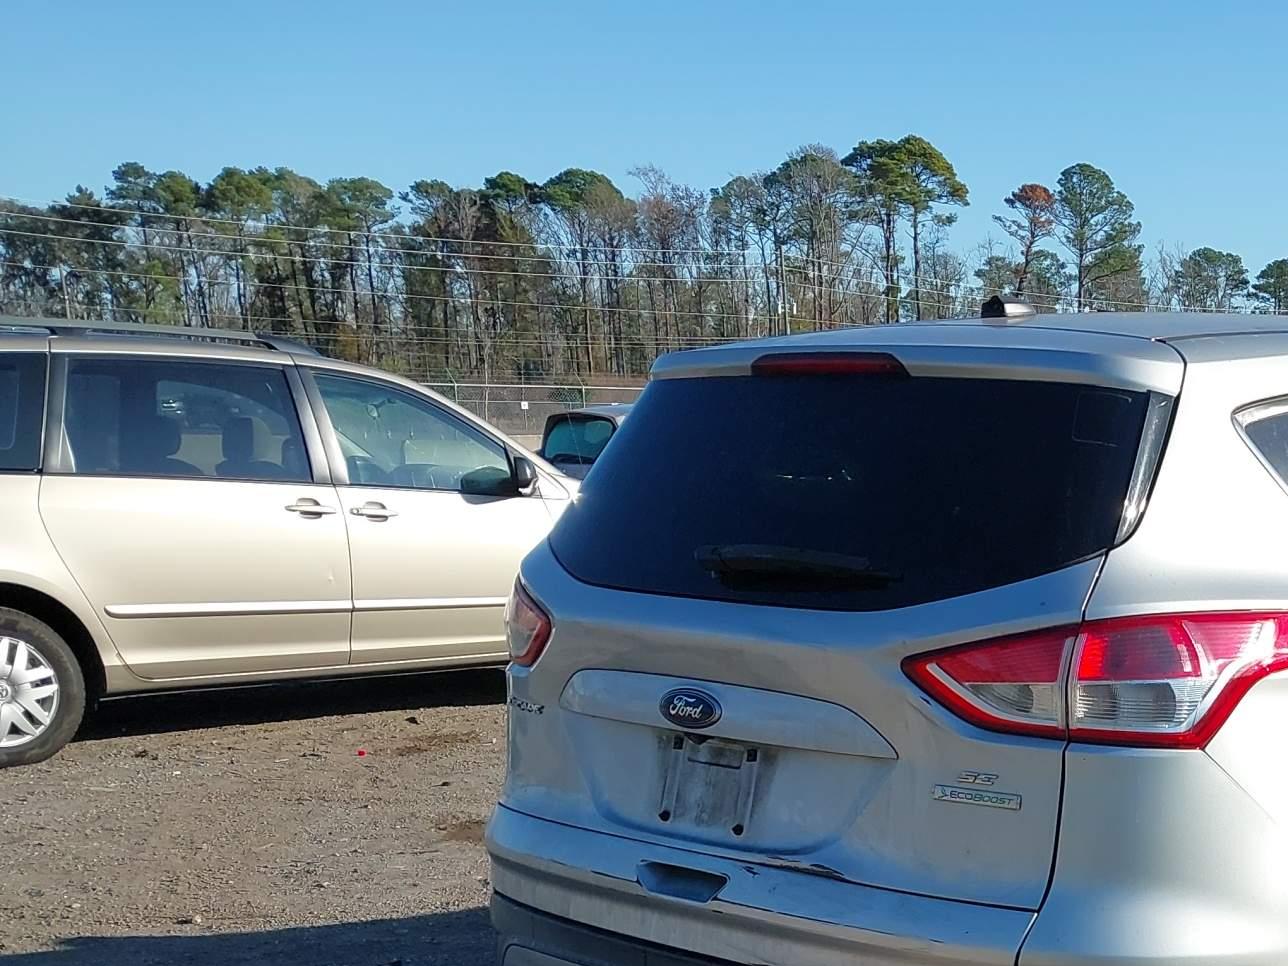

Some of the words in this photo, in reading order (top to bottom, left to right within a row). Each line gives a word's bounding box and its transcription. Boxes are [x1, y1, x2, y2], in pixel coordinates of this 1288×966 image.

[669, 695, 704, 719] Ford
[957, 769, 999, 785] SE
[949, 789, 1014, 806] ECOBOOST
